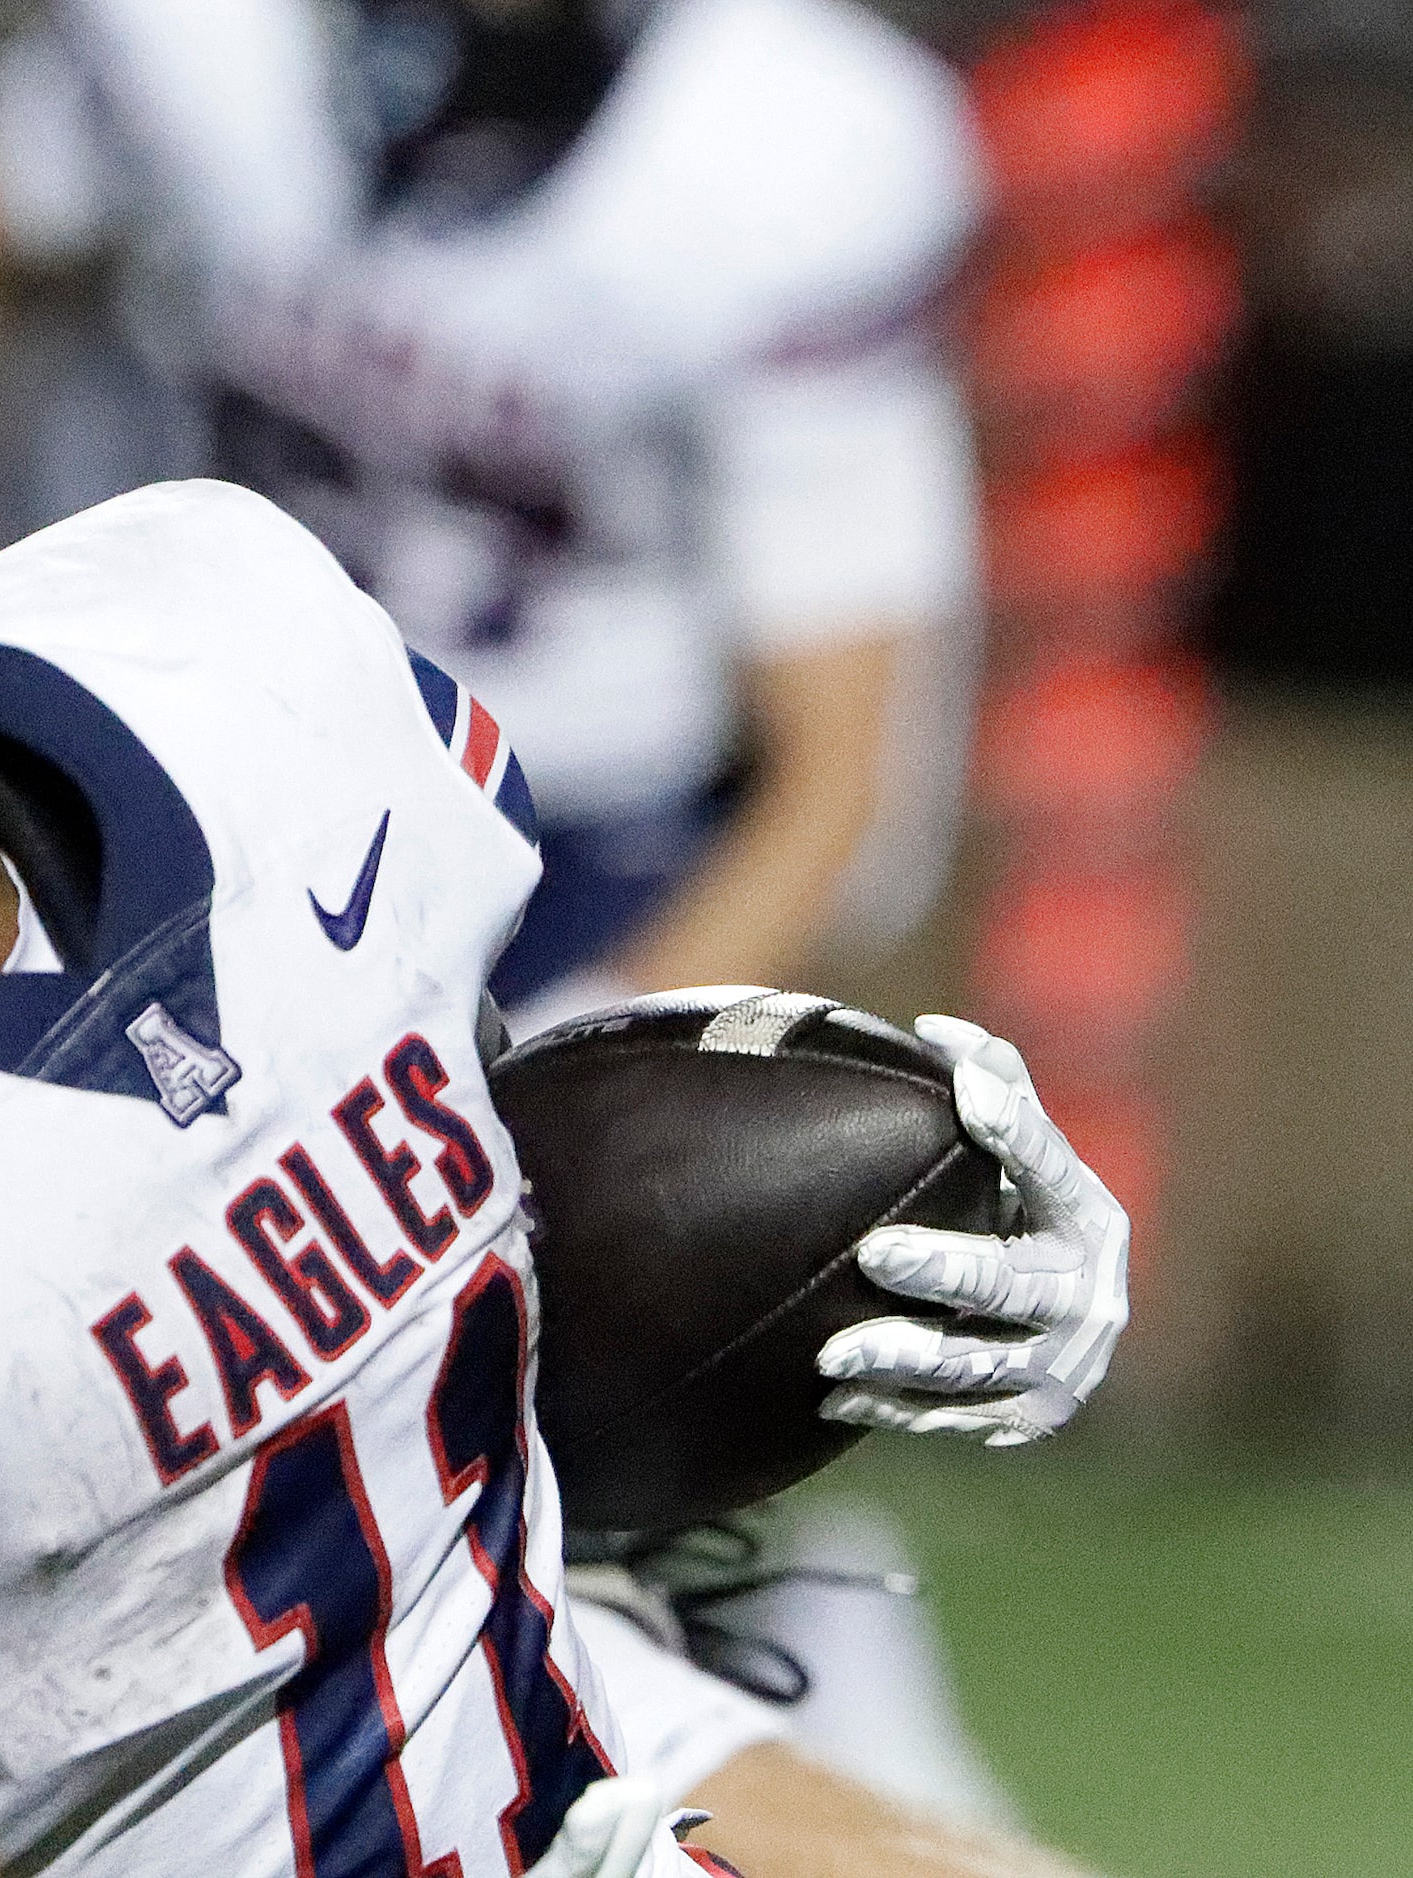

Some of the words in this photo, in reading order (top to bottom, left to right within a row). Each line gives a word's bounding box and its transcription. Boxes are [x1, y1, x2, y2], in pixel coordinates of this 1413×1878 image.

[89, 1031, 495, 1488] EAGLES
[125, 1002, 243, 1130] A
[223, 1251, 618, 1878] 11
